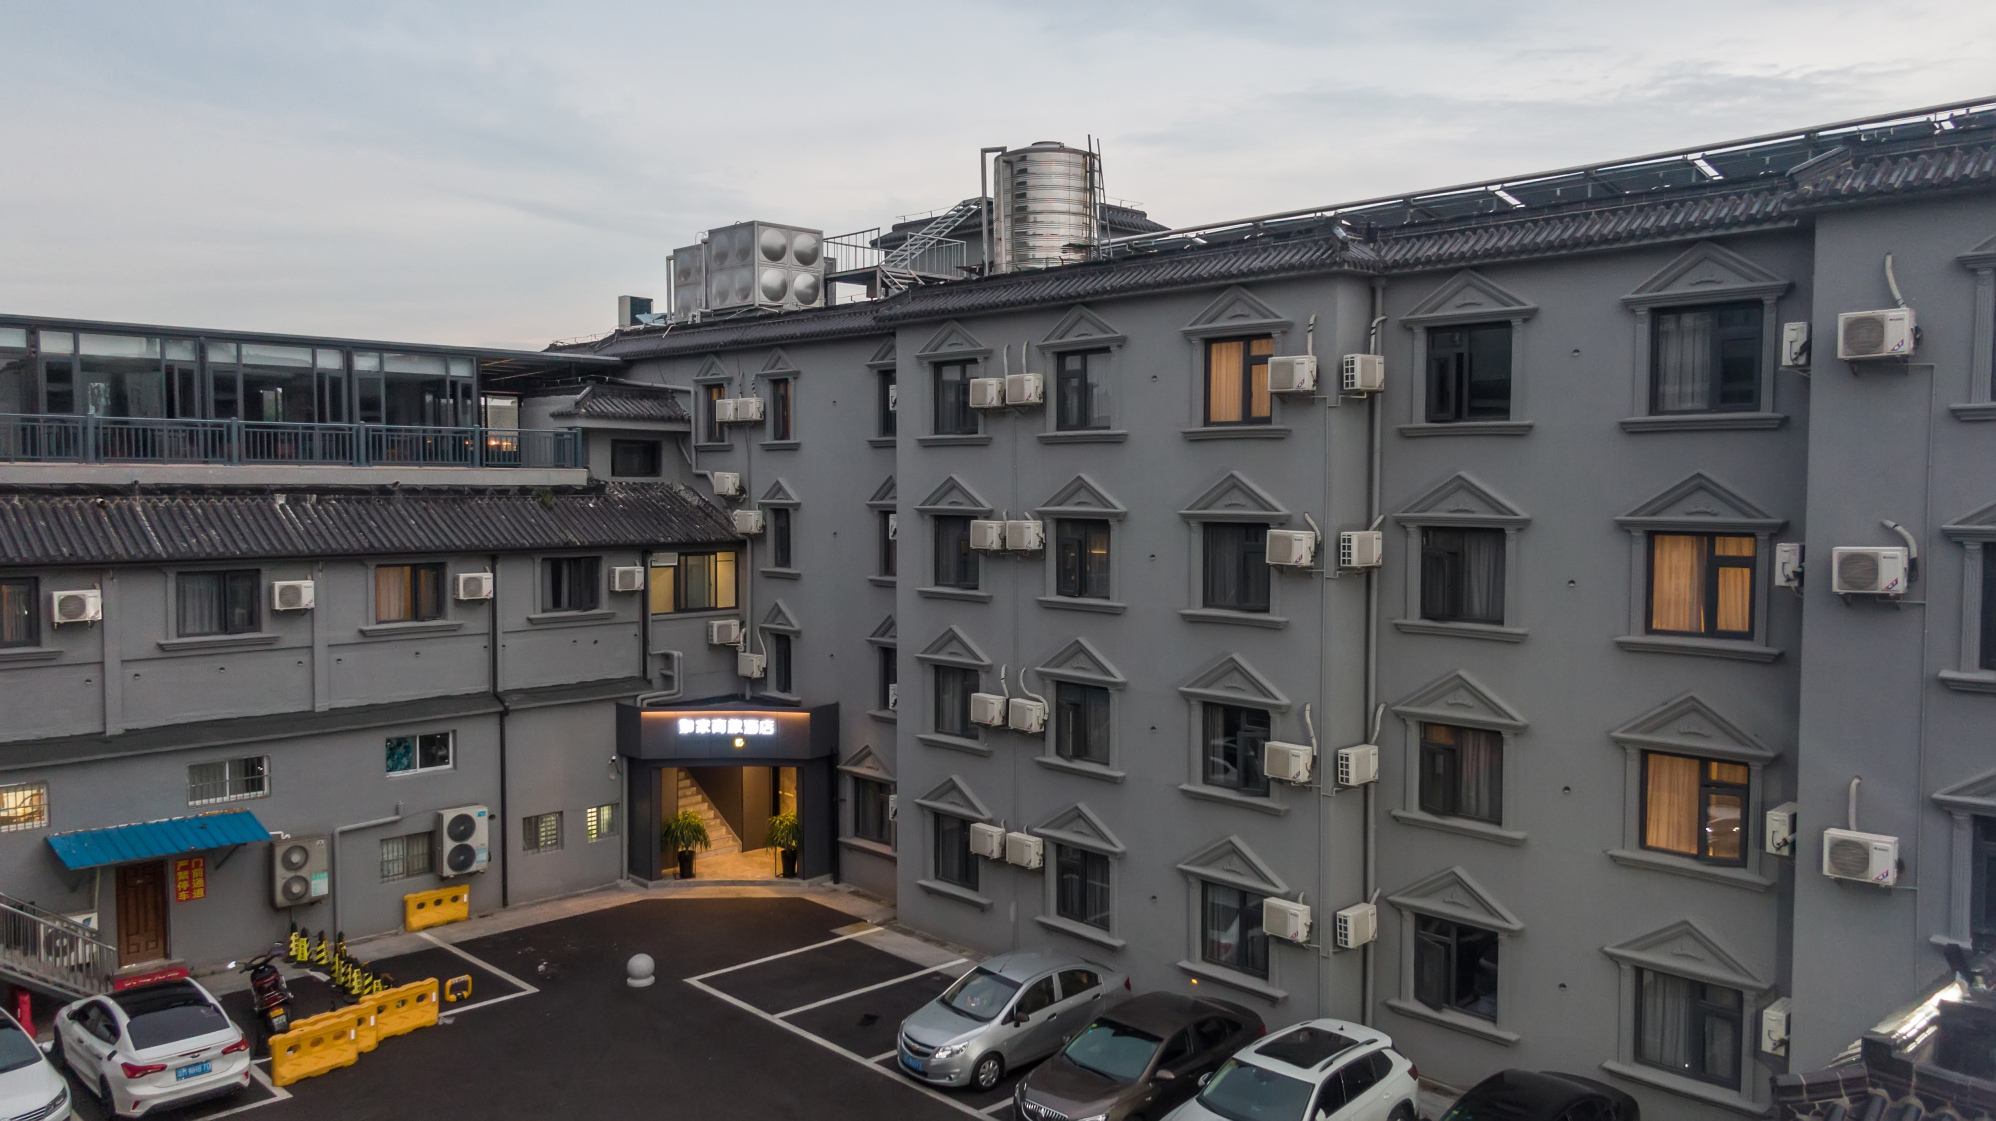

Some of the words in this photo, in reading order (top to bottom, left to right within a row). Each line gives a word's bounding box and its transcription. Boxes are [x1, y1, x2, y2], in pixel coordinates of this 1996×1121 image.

[177, 860, 190, 901] 严禁停车
[192, 858, 205, 899] 门前通道
